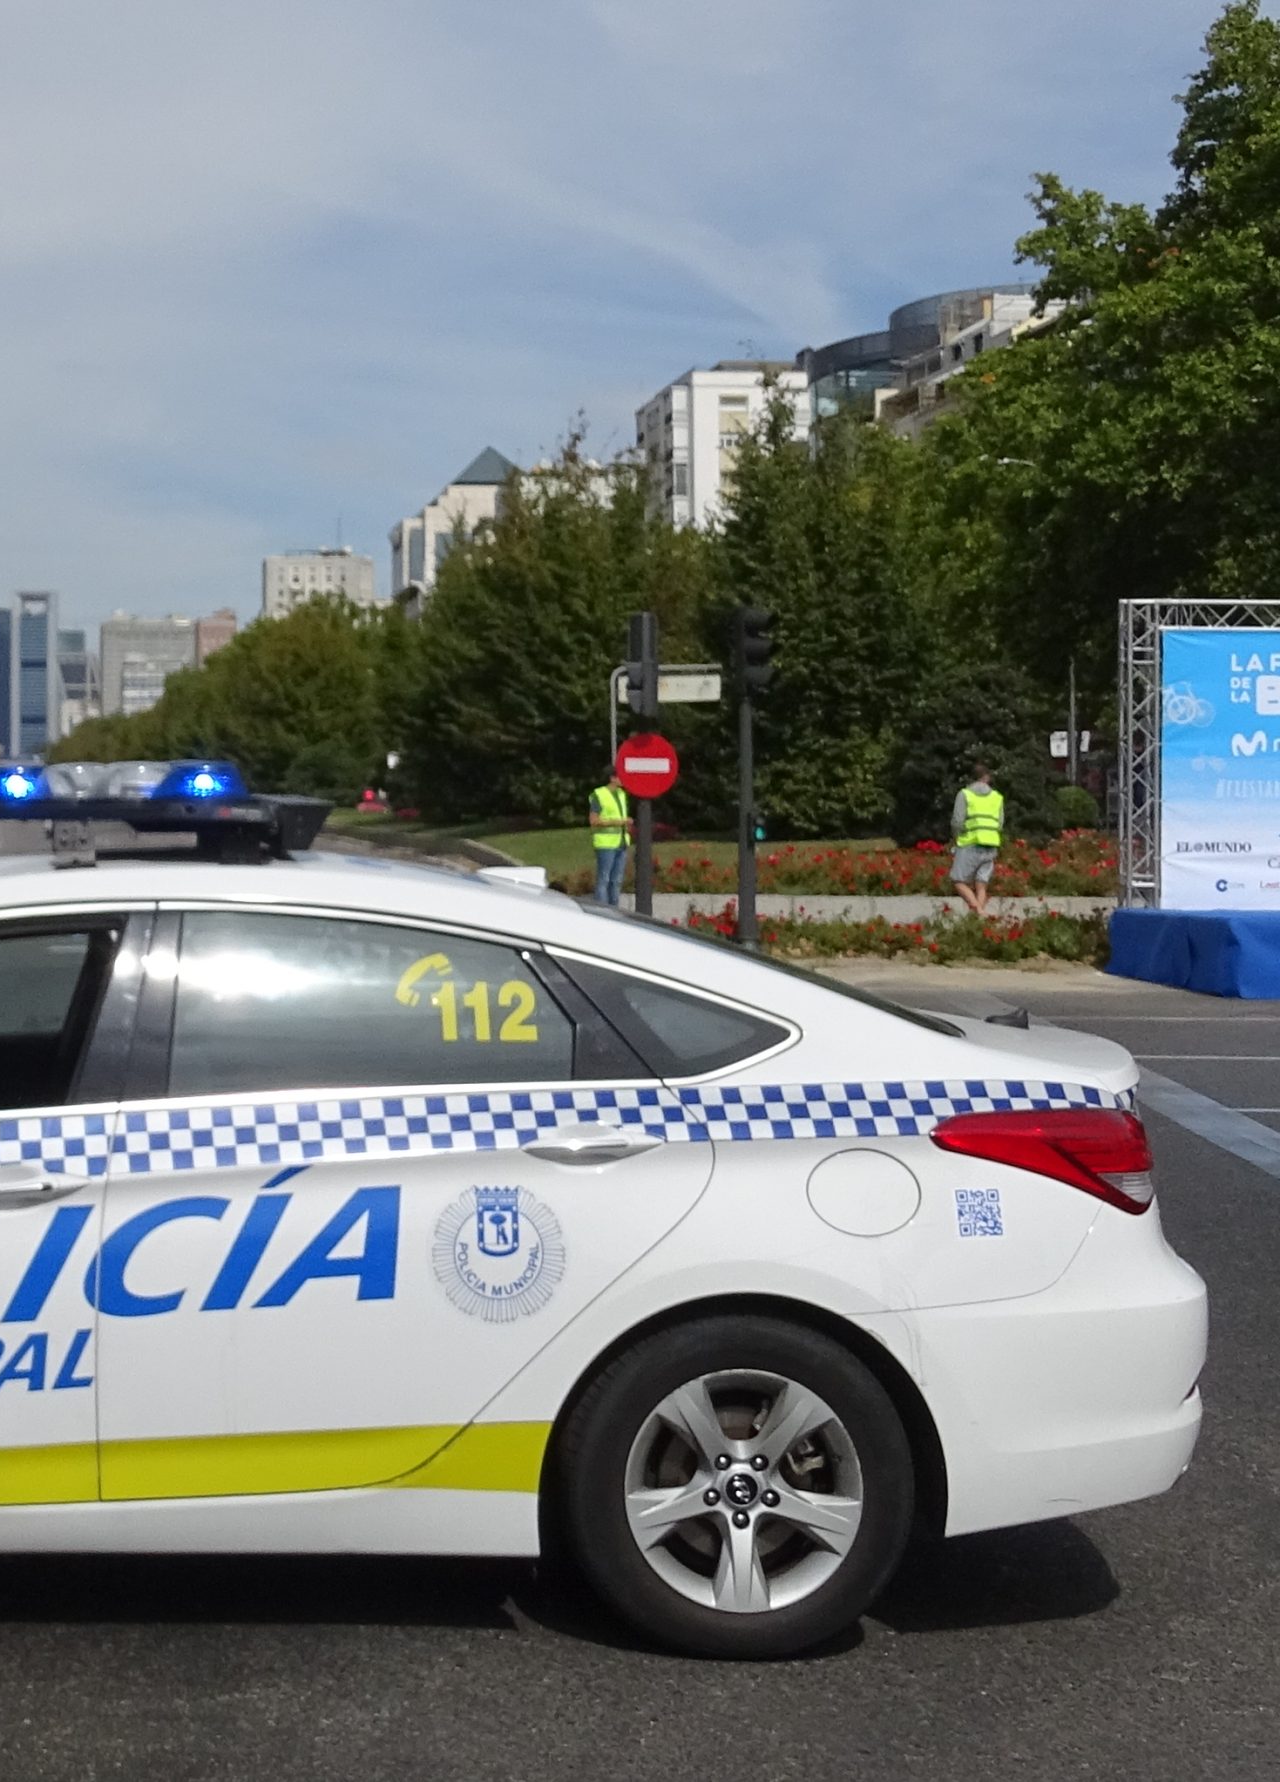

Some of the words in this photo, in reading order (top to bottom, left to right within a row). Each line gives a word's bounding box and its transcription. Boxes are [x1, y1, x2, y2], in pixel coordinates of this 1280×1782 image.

[1231, 653, 1264, 671] LA
[1230, 677, 1251, 689] DE
[1230, 690, 1251, 703] LA
[1204, 842, 1252, 853] MUNDO
[431, 980, 538, 1041] 112
[491, 1242, 539, 1296] MUNICIPAL
